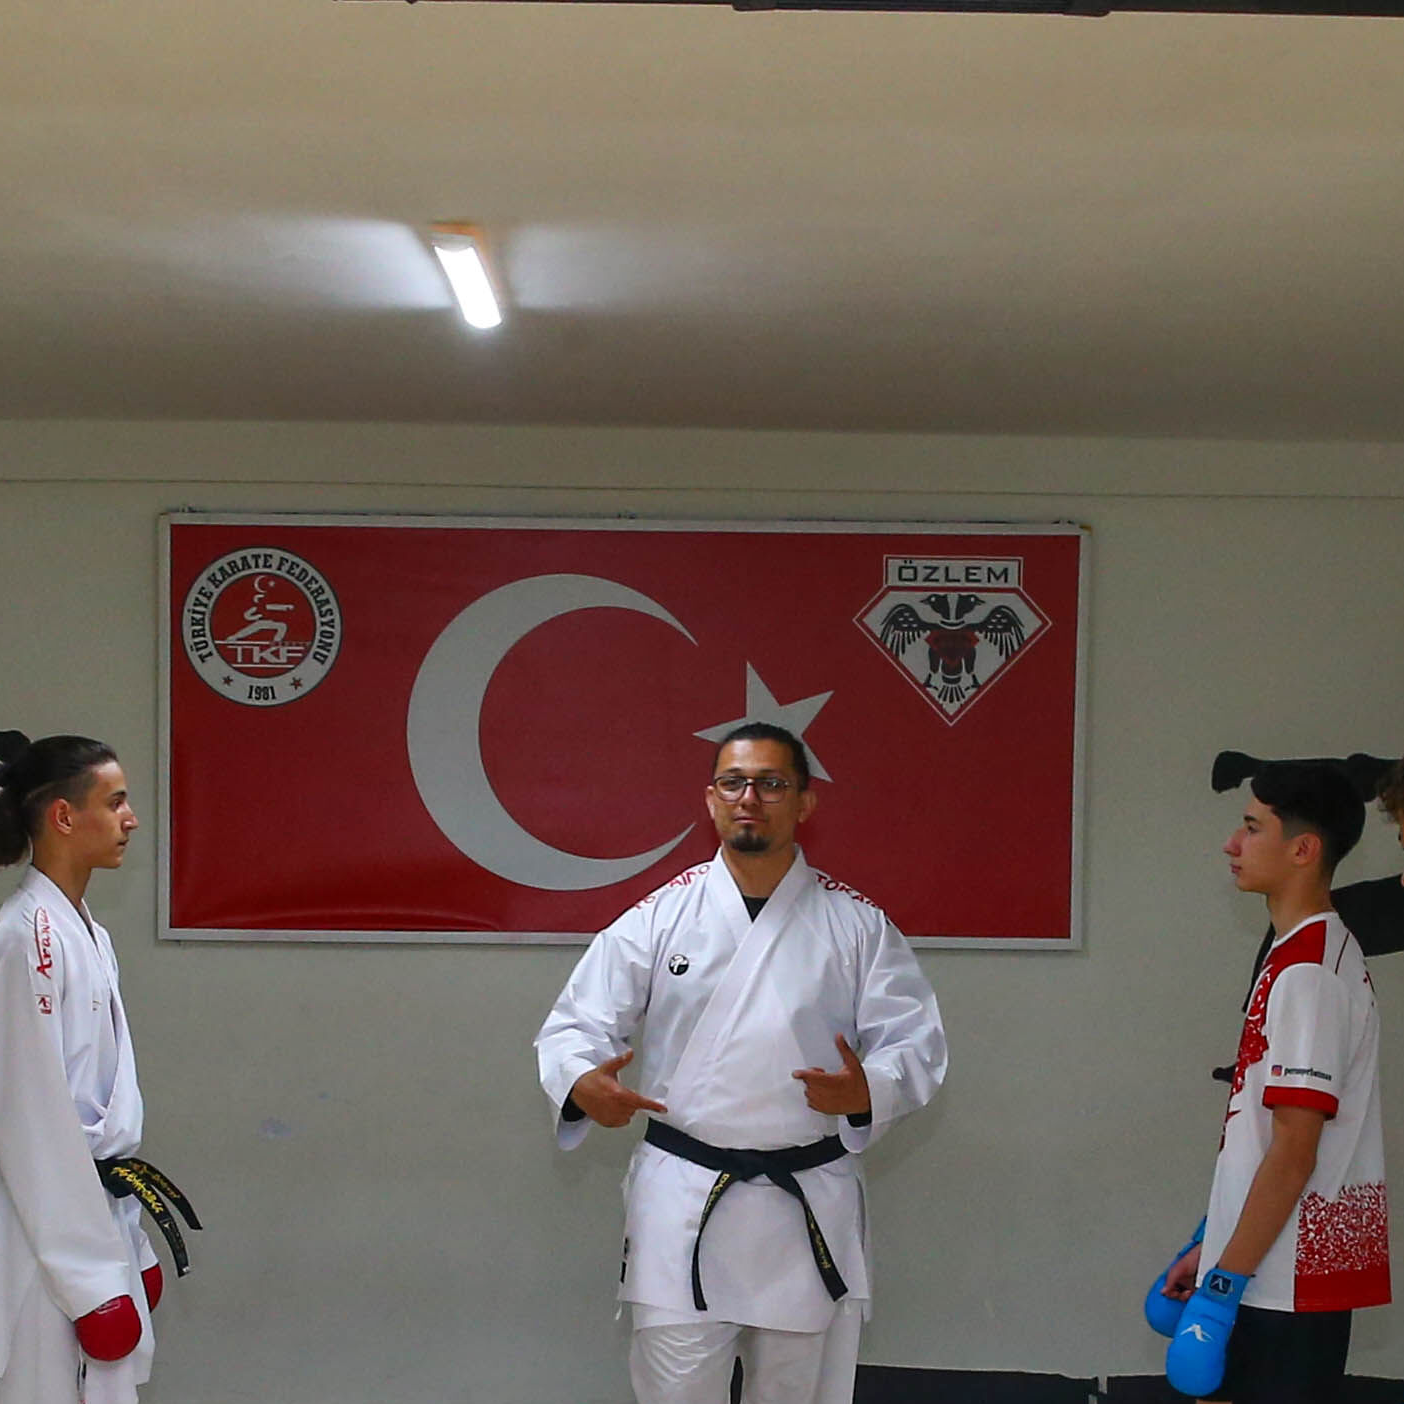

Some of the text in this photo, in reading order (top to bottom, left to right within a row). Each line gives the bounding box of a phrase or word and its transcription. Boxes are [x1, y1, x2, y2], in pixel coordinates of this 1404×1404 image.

[898, 559, 1009, 584] ÖZLEM
[187, 553, 336, 665] TÜRKİYE KARATE FEDERASYONU
[227, 645, 305, 664] TKF
[248, 685, 277, 701] 1981
